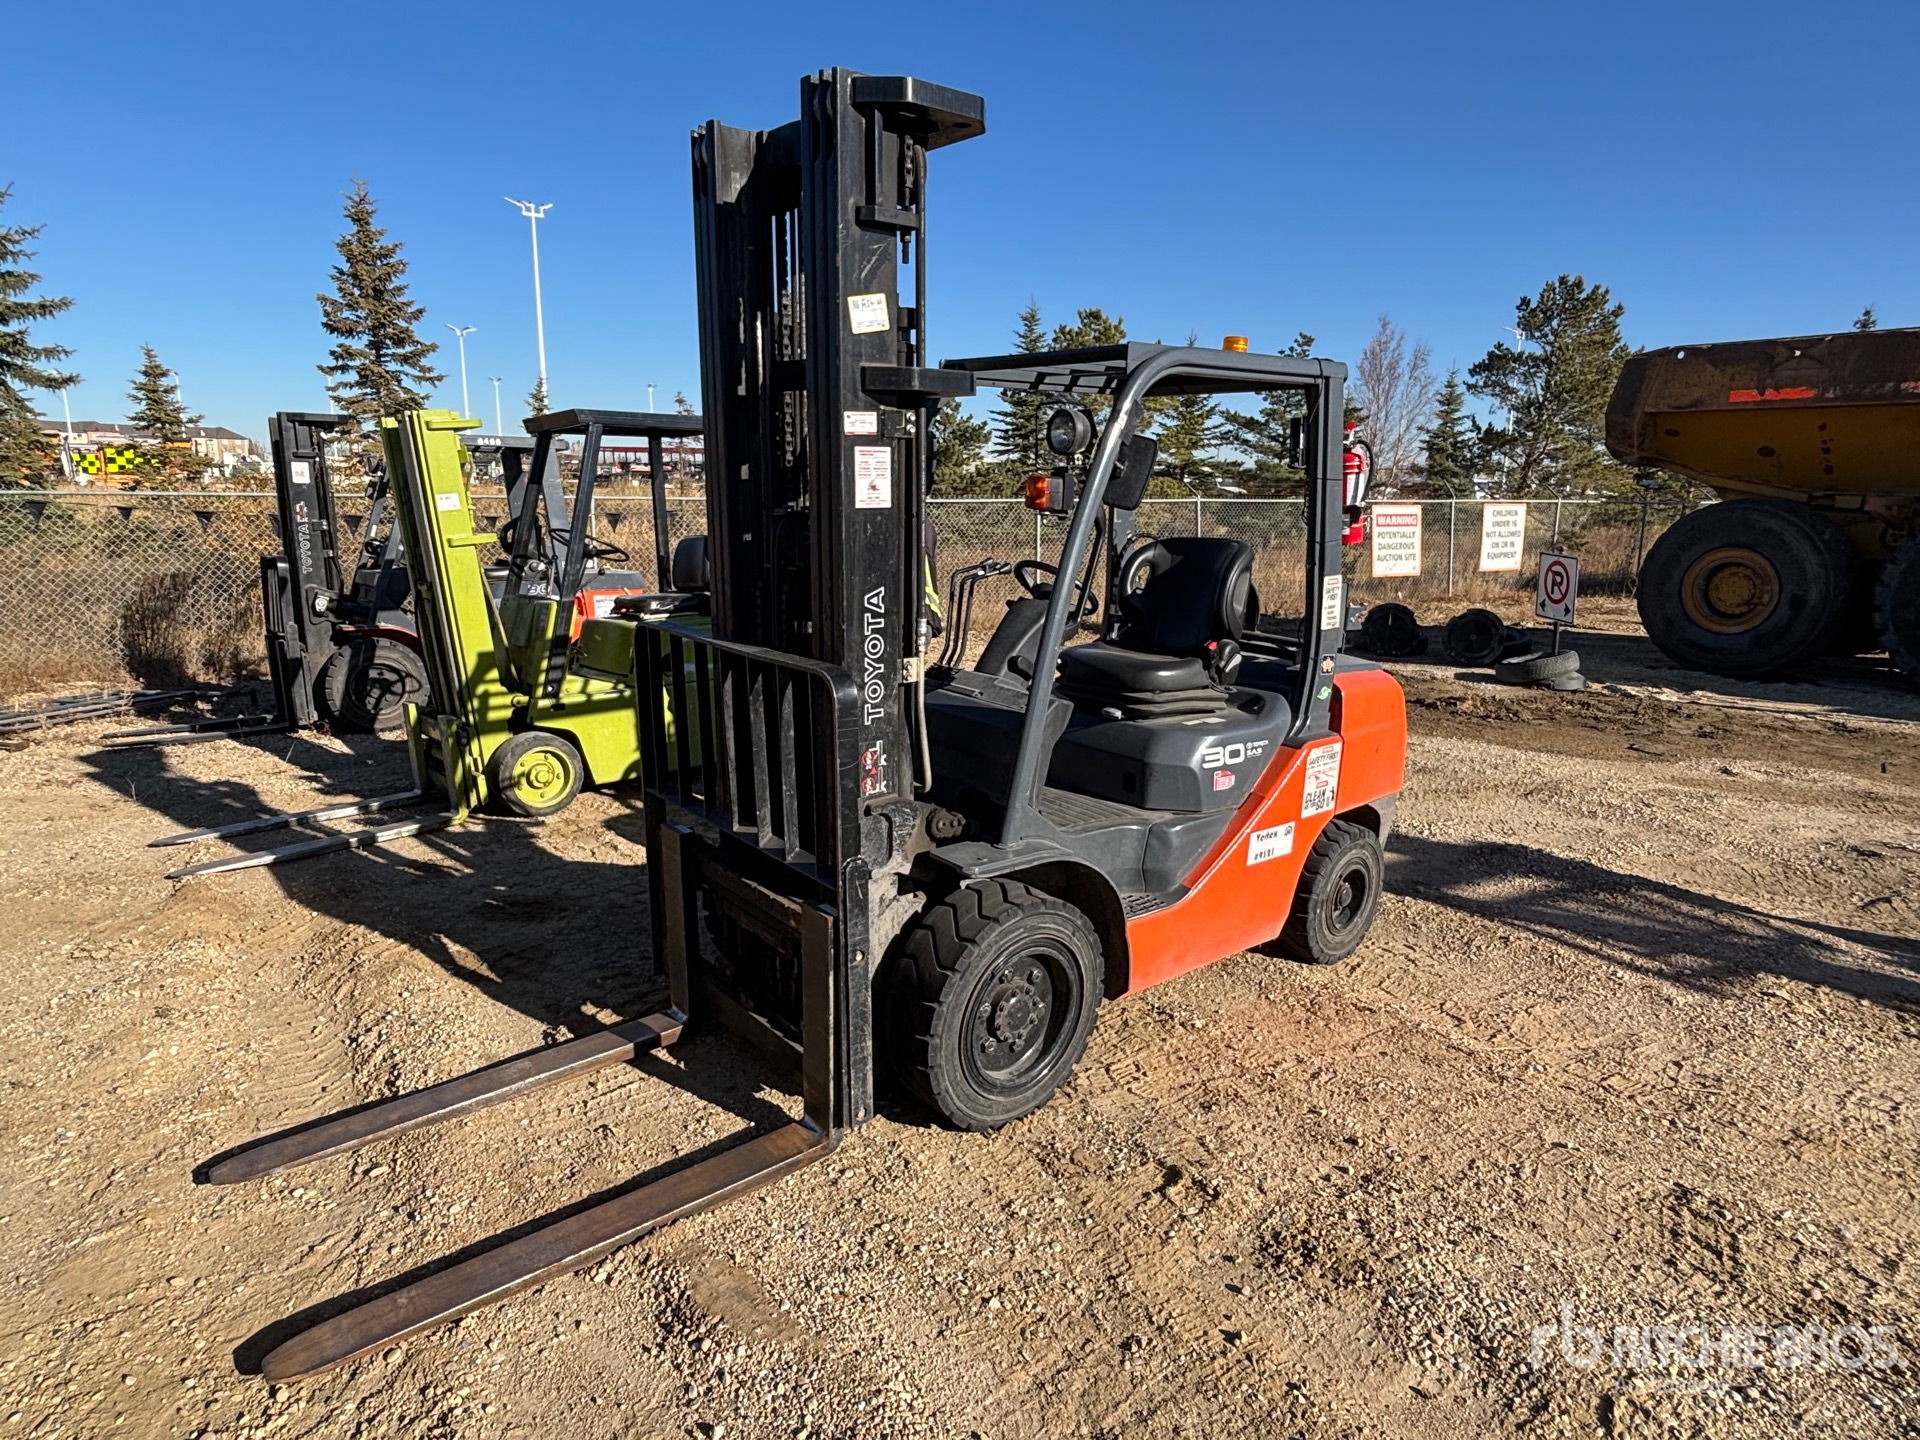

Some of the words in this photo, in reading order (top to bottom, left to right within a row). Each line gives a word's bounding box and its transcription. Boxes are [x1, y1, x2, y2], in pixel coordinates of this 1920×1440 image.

[1492, 509, 1518, 517] CHILDREN
[1377, 515, 1417, 526] WARNING
[1491, 520, 1510, 528] UNDER
[1377, 531, 1416, 539] POTENTIALLY
[1497, 530, 1521, 538] ALLOWED
[298, 524, 313, 574] TOYOTA
[1377, 542, 1415, 551] DANGEROUS
[1491, 541, 1500, 549] ON
[1377, 553, 1403, 562] AUCTION
[1404, 553, 1416, 561] SITE
[1487, 551, 1517, 560] EQUIPMENT
[864, 586, 885, 726] TOYOTA
[1201, 743, 1245, 769] 30
[1246, 747, 1263, 756] SAS
[1308, 754, 1326, 766] SAFETY
[1305, 788, 1327, 804] CLEAN
